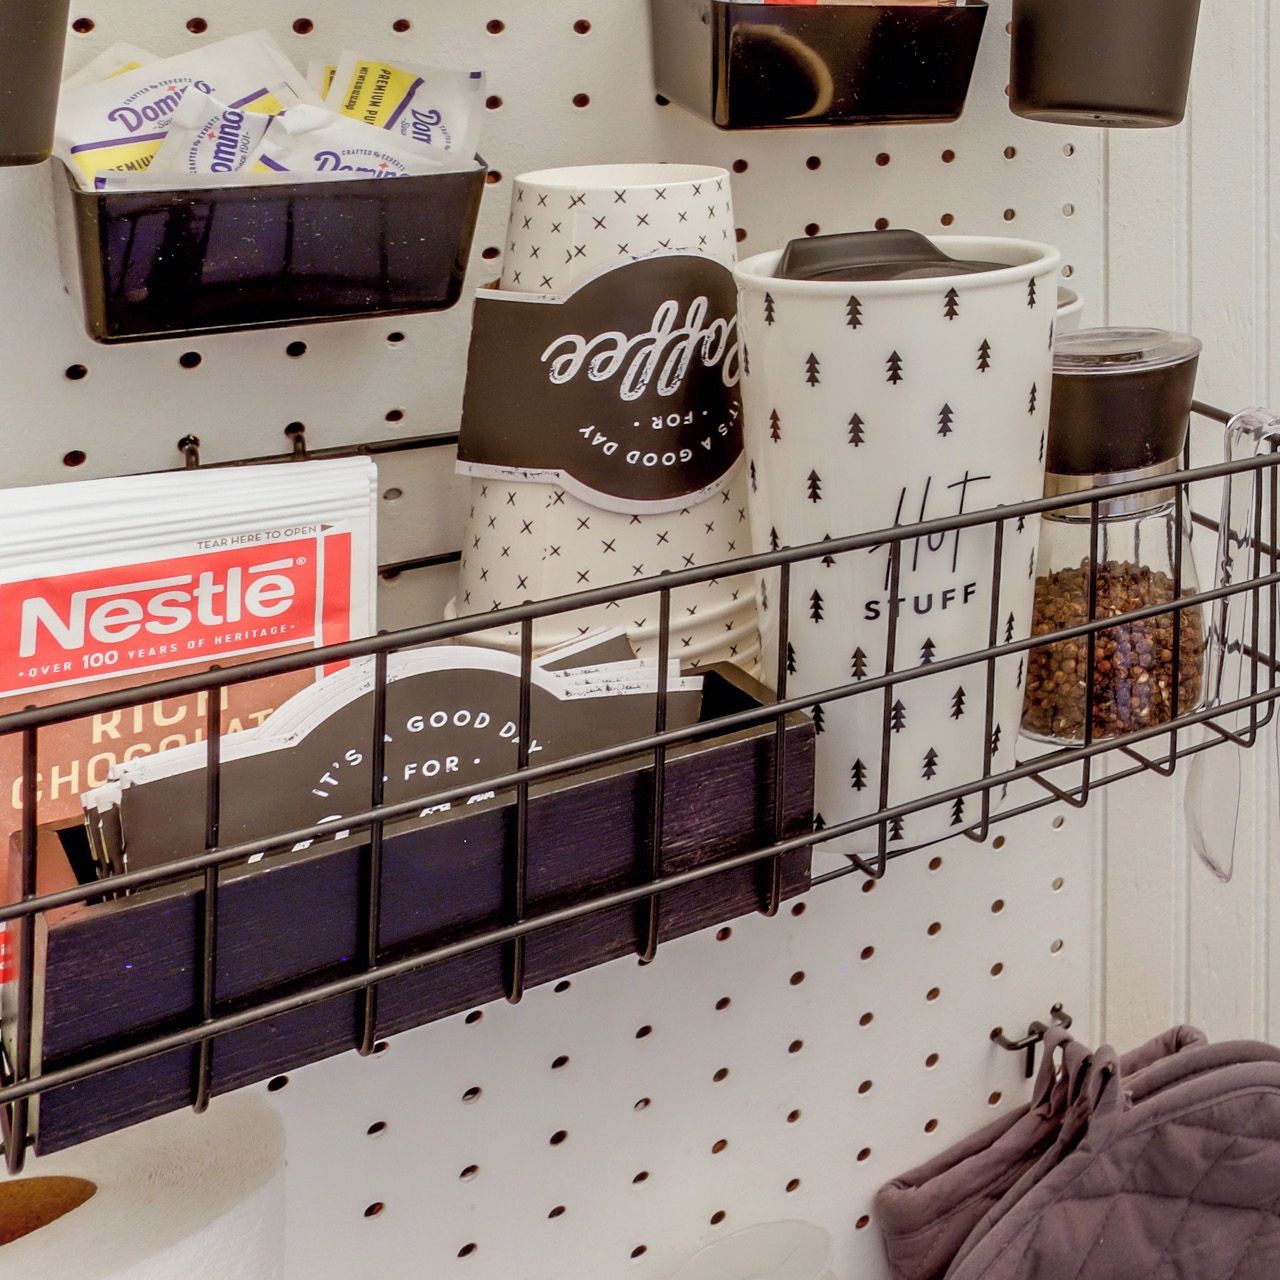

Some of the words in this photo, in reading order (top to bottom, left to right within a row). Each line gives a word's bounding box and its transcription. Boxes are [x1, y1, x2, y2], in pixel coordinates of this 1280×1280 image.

[368, 69, 392, 107] PREMIUM
[107, 80, 212, 133] Domio
[363, 109, 378, 126] PU
[210, 110, 244, 173] omino
[411, 109, 442, 145] Dom
[651, 411, 693, 429] FOR
[579, 425, 618, 455] DAY
[701, 437, 711, 450] A
[626, 448, 692, 466] GOOD
[197, 538, 228, 550] TEAR
[231, 534, 262, 545] HERE
[265, 530, 281, 540] TO
[284, 525, 317, 537] OPEN
[82, 650, 119, 670] 100
[128, 643, 178, 660] YEARS
[187, 637, 205, 649] OF
[214, 624, 288, 646] HERITAGE
[11, 708, 274, 810] CHOAT
[312, 749, 364, 798] IT'S
[406, 709, 491, 733] GOOD
[404, 755, 460, 781] FOR
